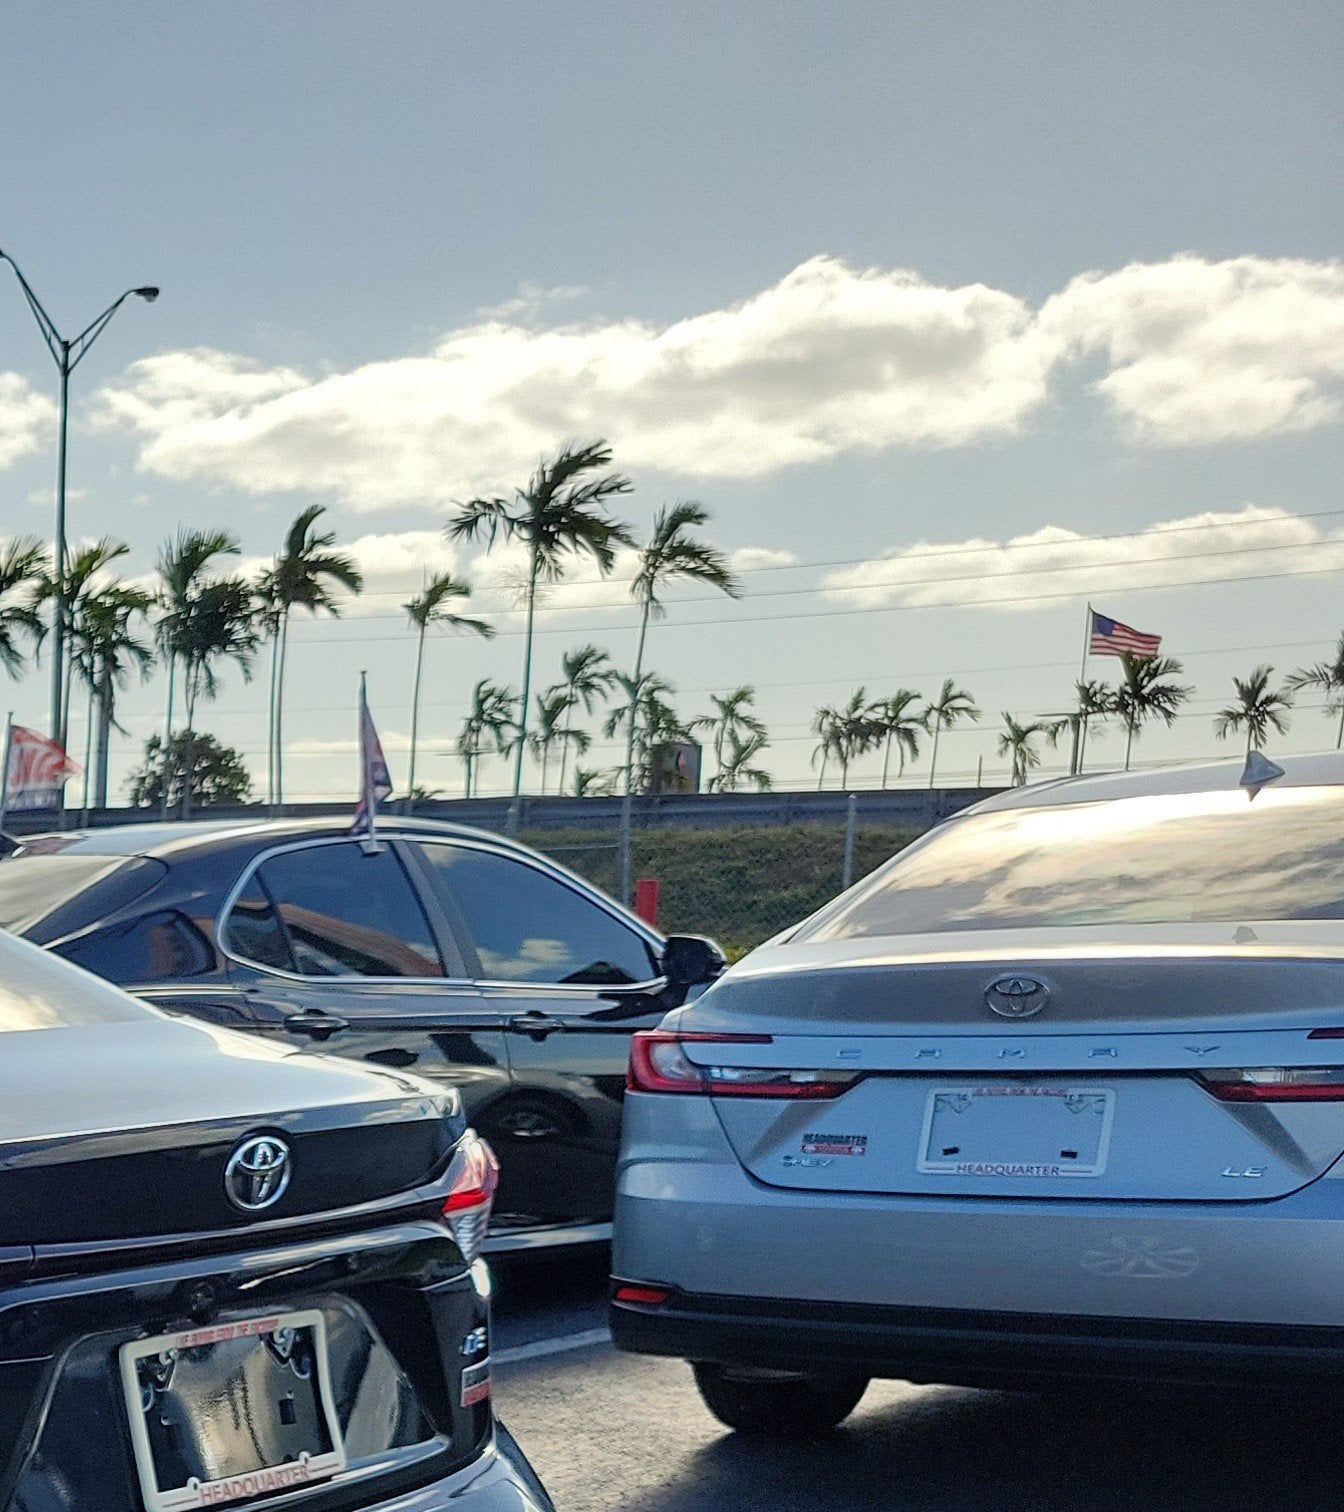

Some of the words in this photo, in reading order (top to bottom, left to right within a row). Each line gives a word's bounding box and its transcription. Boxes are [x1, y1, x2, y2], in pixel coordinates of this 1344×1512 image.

[955, 1163, 1061, 1177] HEADQUARTER
[1221, 1165, 1265, 1179] LE
[200, 1464, 310, 1505] HEADQUARTER
